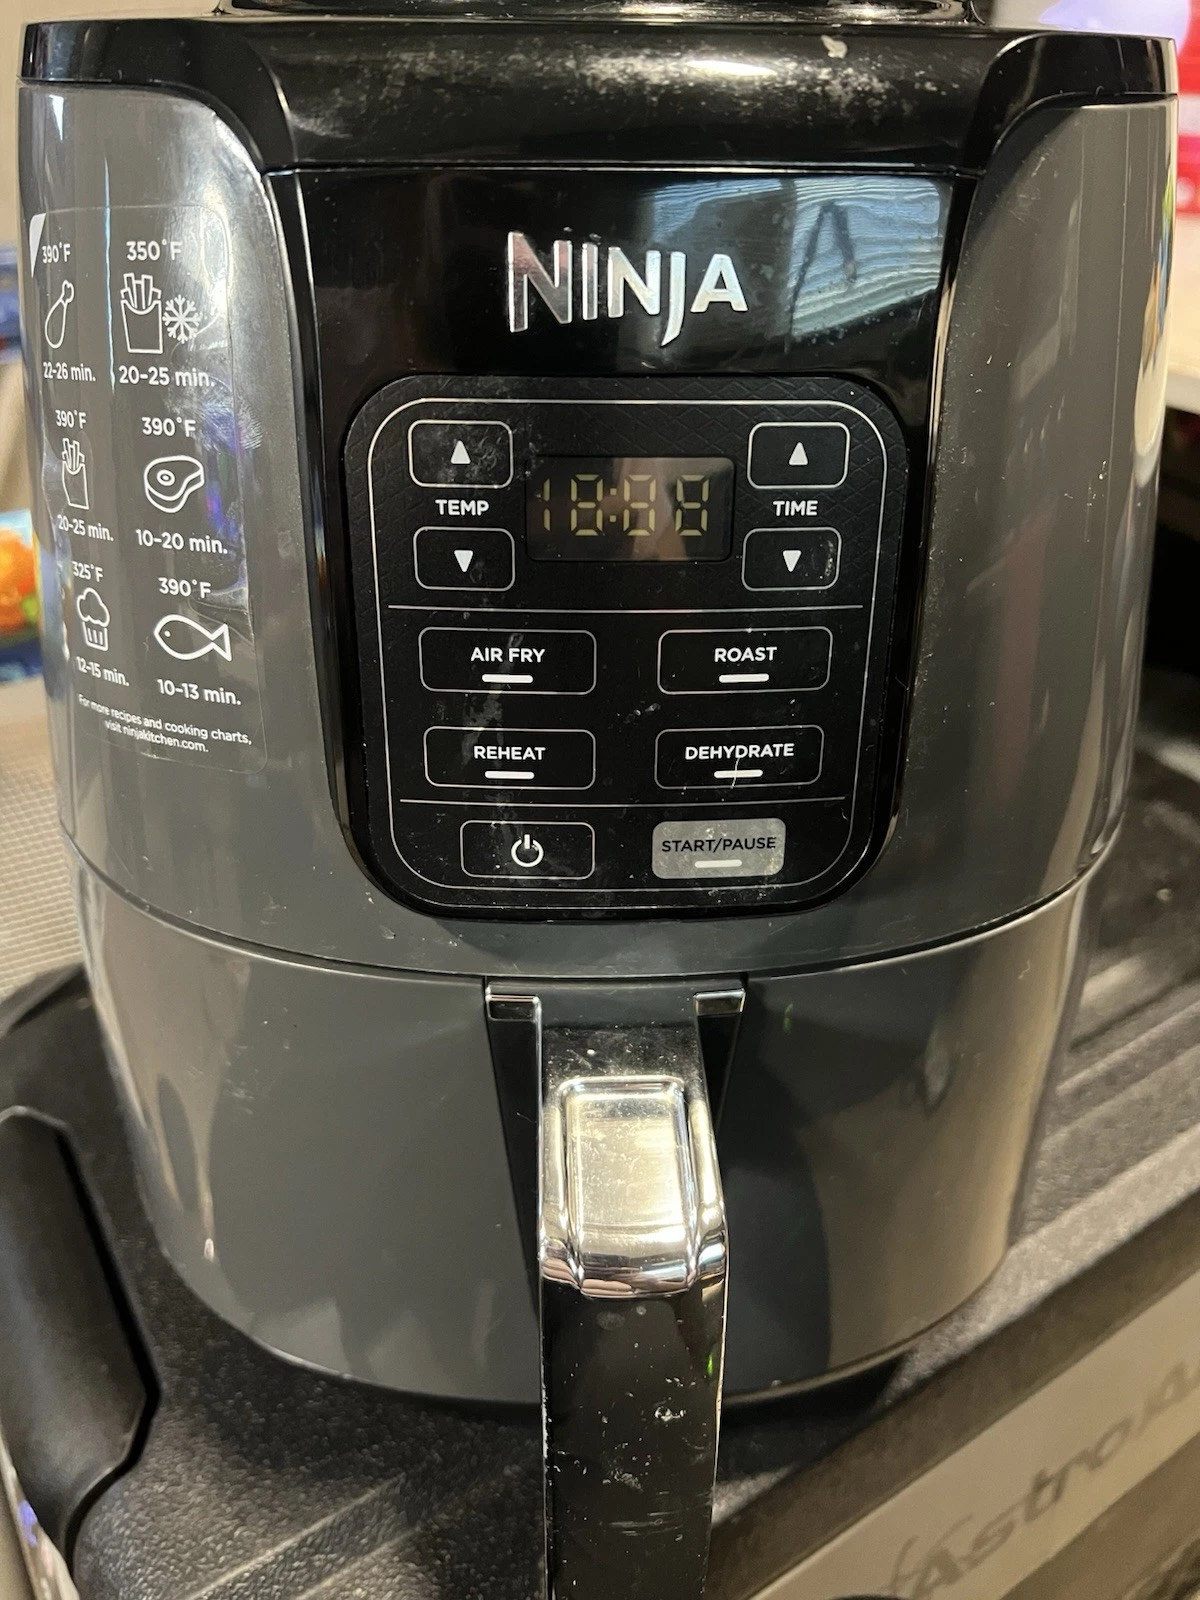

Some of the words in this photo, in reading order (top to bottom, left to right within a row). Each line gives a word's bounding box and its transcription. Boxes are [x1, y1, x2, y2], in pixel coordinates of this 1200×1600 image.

[41, 243, 71, 264] 390°F
[126, 239, 183, 261] 350°F
[508, 231, 748, 346] NINJA
[43, 362, 69, 380] 22-26
[70, 364, 96, 382] min.
[119, 365, 170, 385] 20-25
[175, 367, 215, 387] min.
[55, 409, 87, 429] 390°F
[141, 416, 196, 438] 390°F
[435, 499, 490, 517] TEMP
[772, 499, 819, 517] TIME
[57, 514, 86, 535] 20-25
[87, 524, 114, 542] min.
[136, 529, 184, 551] 10-20
[189, 534, 228, 554] min.
[72, 561, 103, 582] 325°F
[158, 577, 211, 598] 390°F
[470, 646, 504, 664] AIR
[508, 647, 546, 664] FRY
[713, 645, 778, 664] ROAST
[76, 656, 101, 679] 12-15
[103, 668, 130, 687] min.
[157, 679, 200, 700] 10-13
[203, 687, 242, 706] min.
[78, 693, 91, 706] For
[90, 701, 110, 716] more
[110, 709, 142, 725] recipes
[143, 717, 163, 730] and
[164, 722, 209, 741] cooking
[210, 728, 252, 745] charts,
[104, 719, 122, 735] visit
[123, 726, 209, 752] ninjakitchen.com.
[473, 744, 547, 762] REHEAT
[684, 742, 796, 762] DEHYDRATE
[660, 835, 778, 855] START/PAUSE
